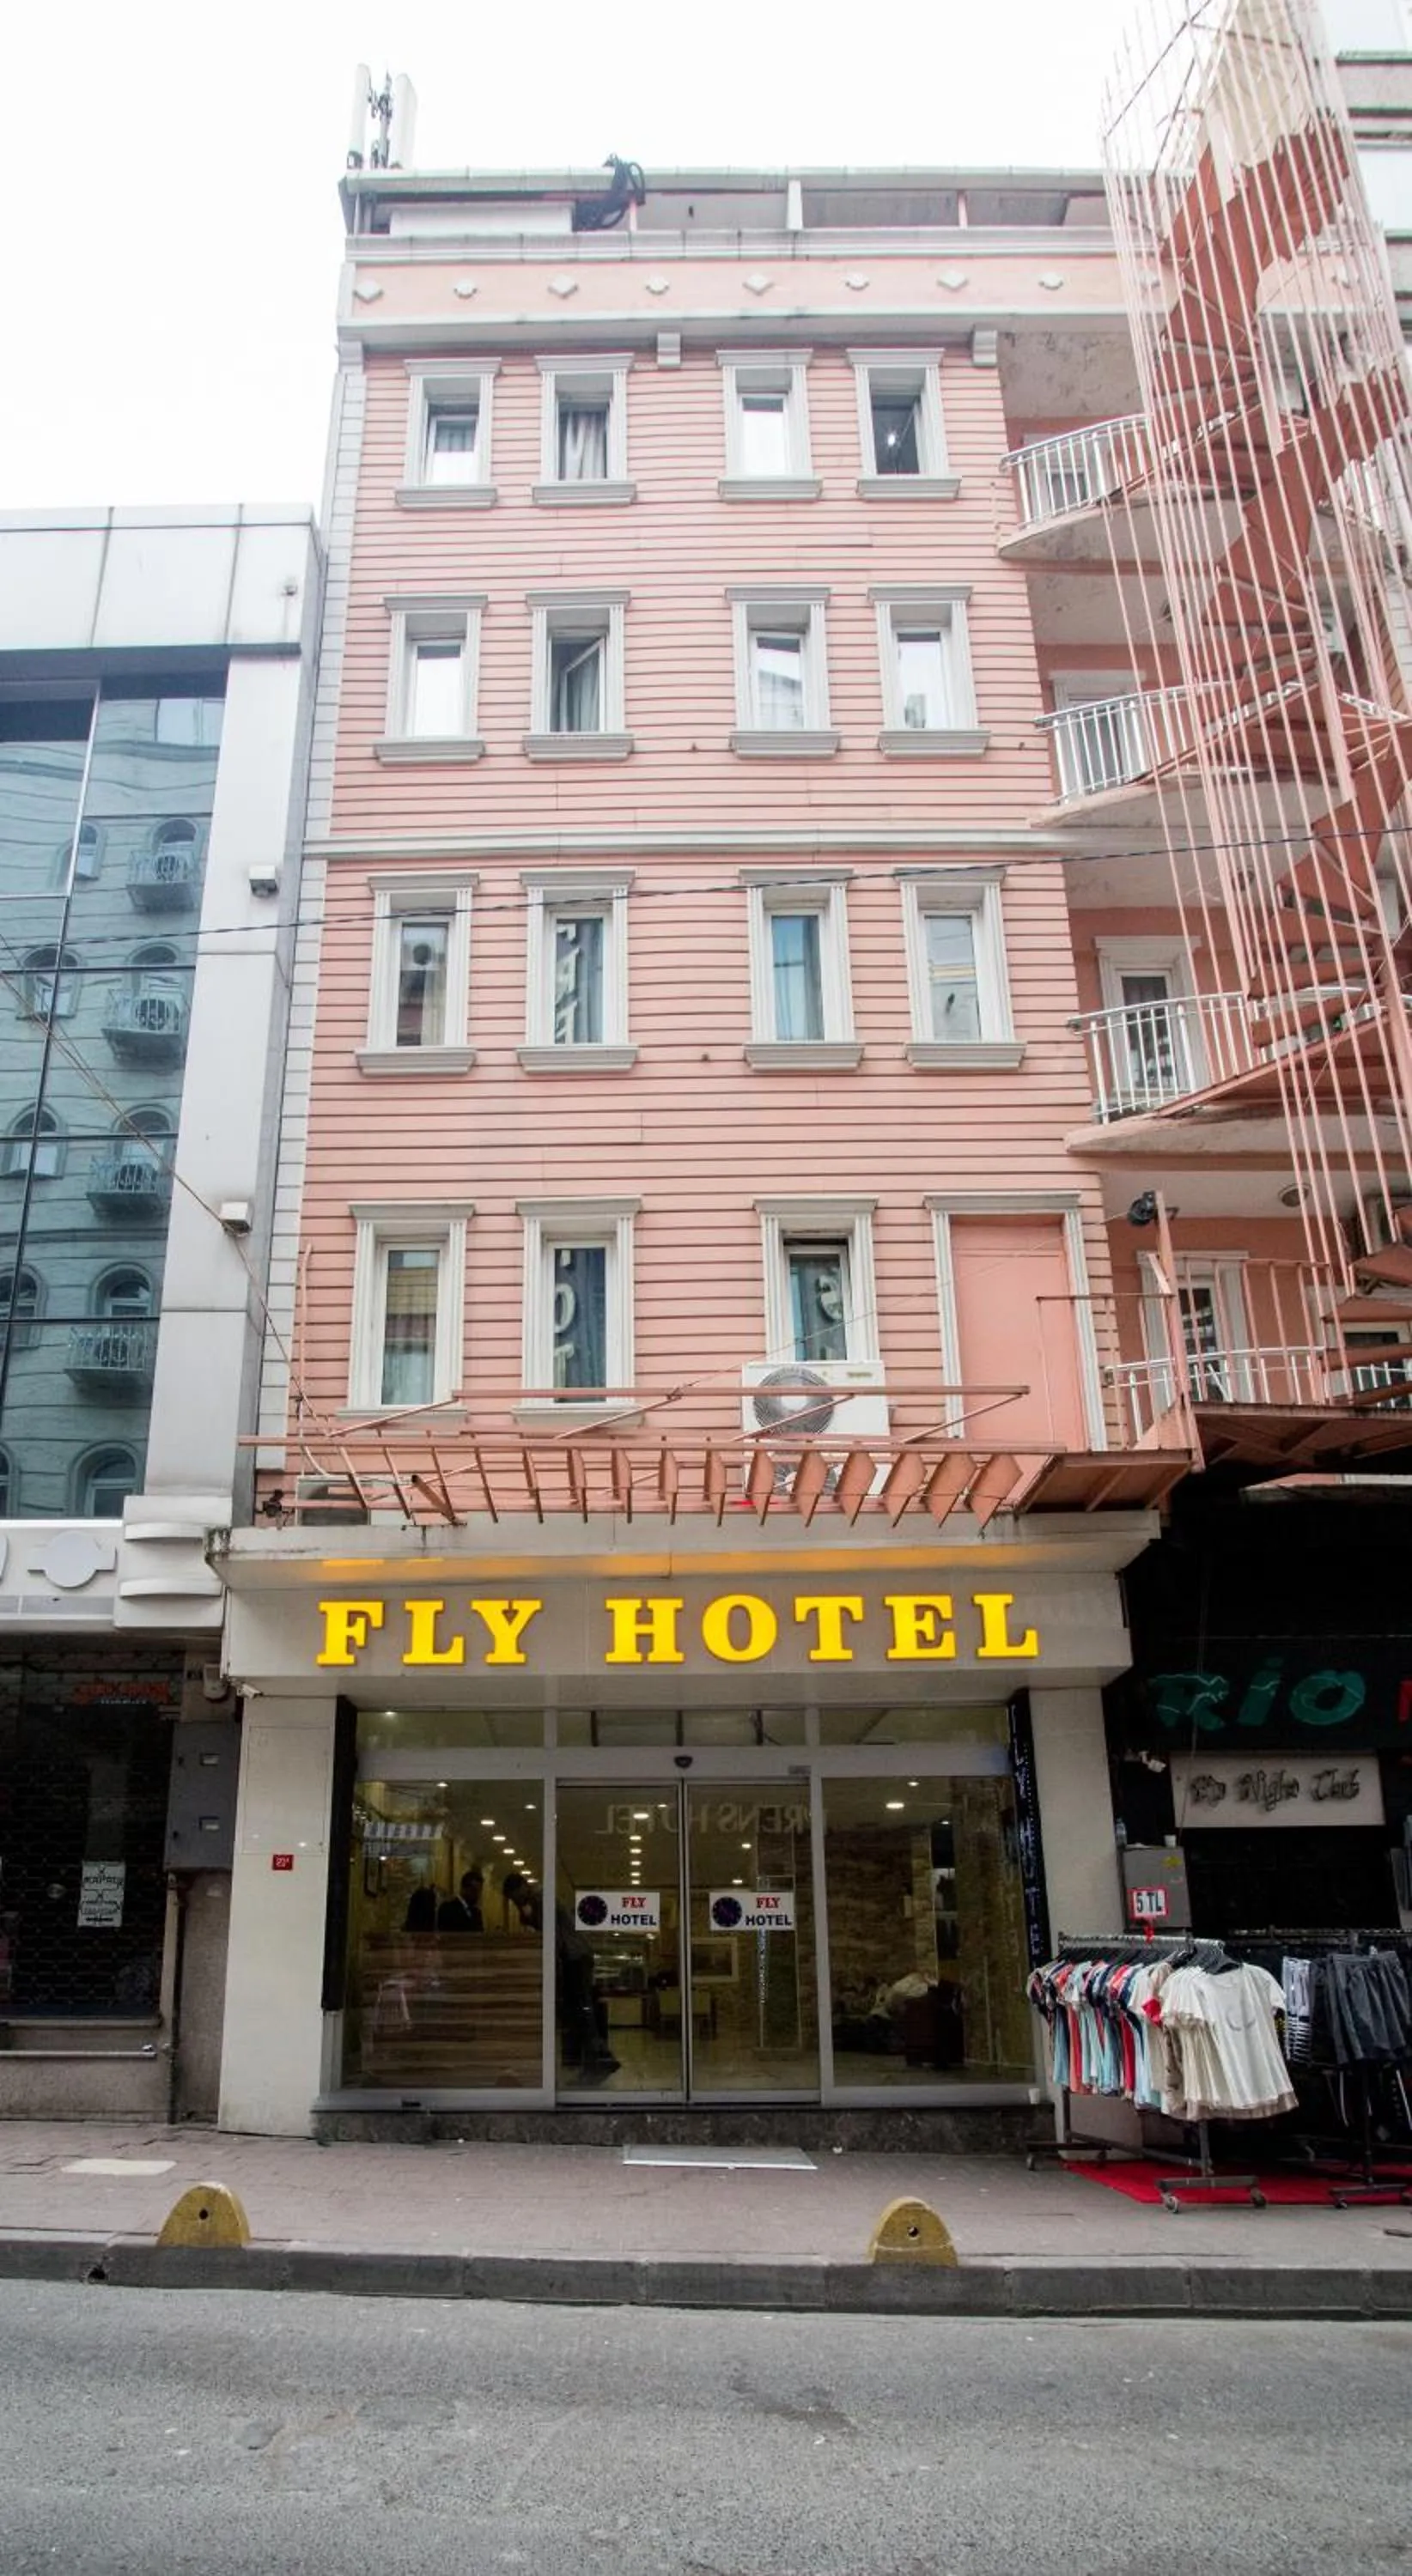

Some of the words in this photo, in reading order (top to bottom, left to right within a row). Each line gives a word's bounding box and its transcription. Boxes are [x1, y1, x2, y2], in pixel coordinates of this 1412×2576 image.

[316, 1599, 543, 1665] FLY
[605, 1594, 1039, 1663] HOTEL
[1019, 1815, 1042, 1970] HOTE
[621, 1896, 647, 1909] FLY
[755, 1897, 781, 1909] FLY
[1136, 1892, 1143, 1912] 5
[1146, 1892, 1162, 1912] TL
[611, 1914, 657, 1926] HOTEL
[745, 1915, 792, 1926] HOTEL
